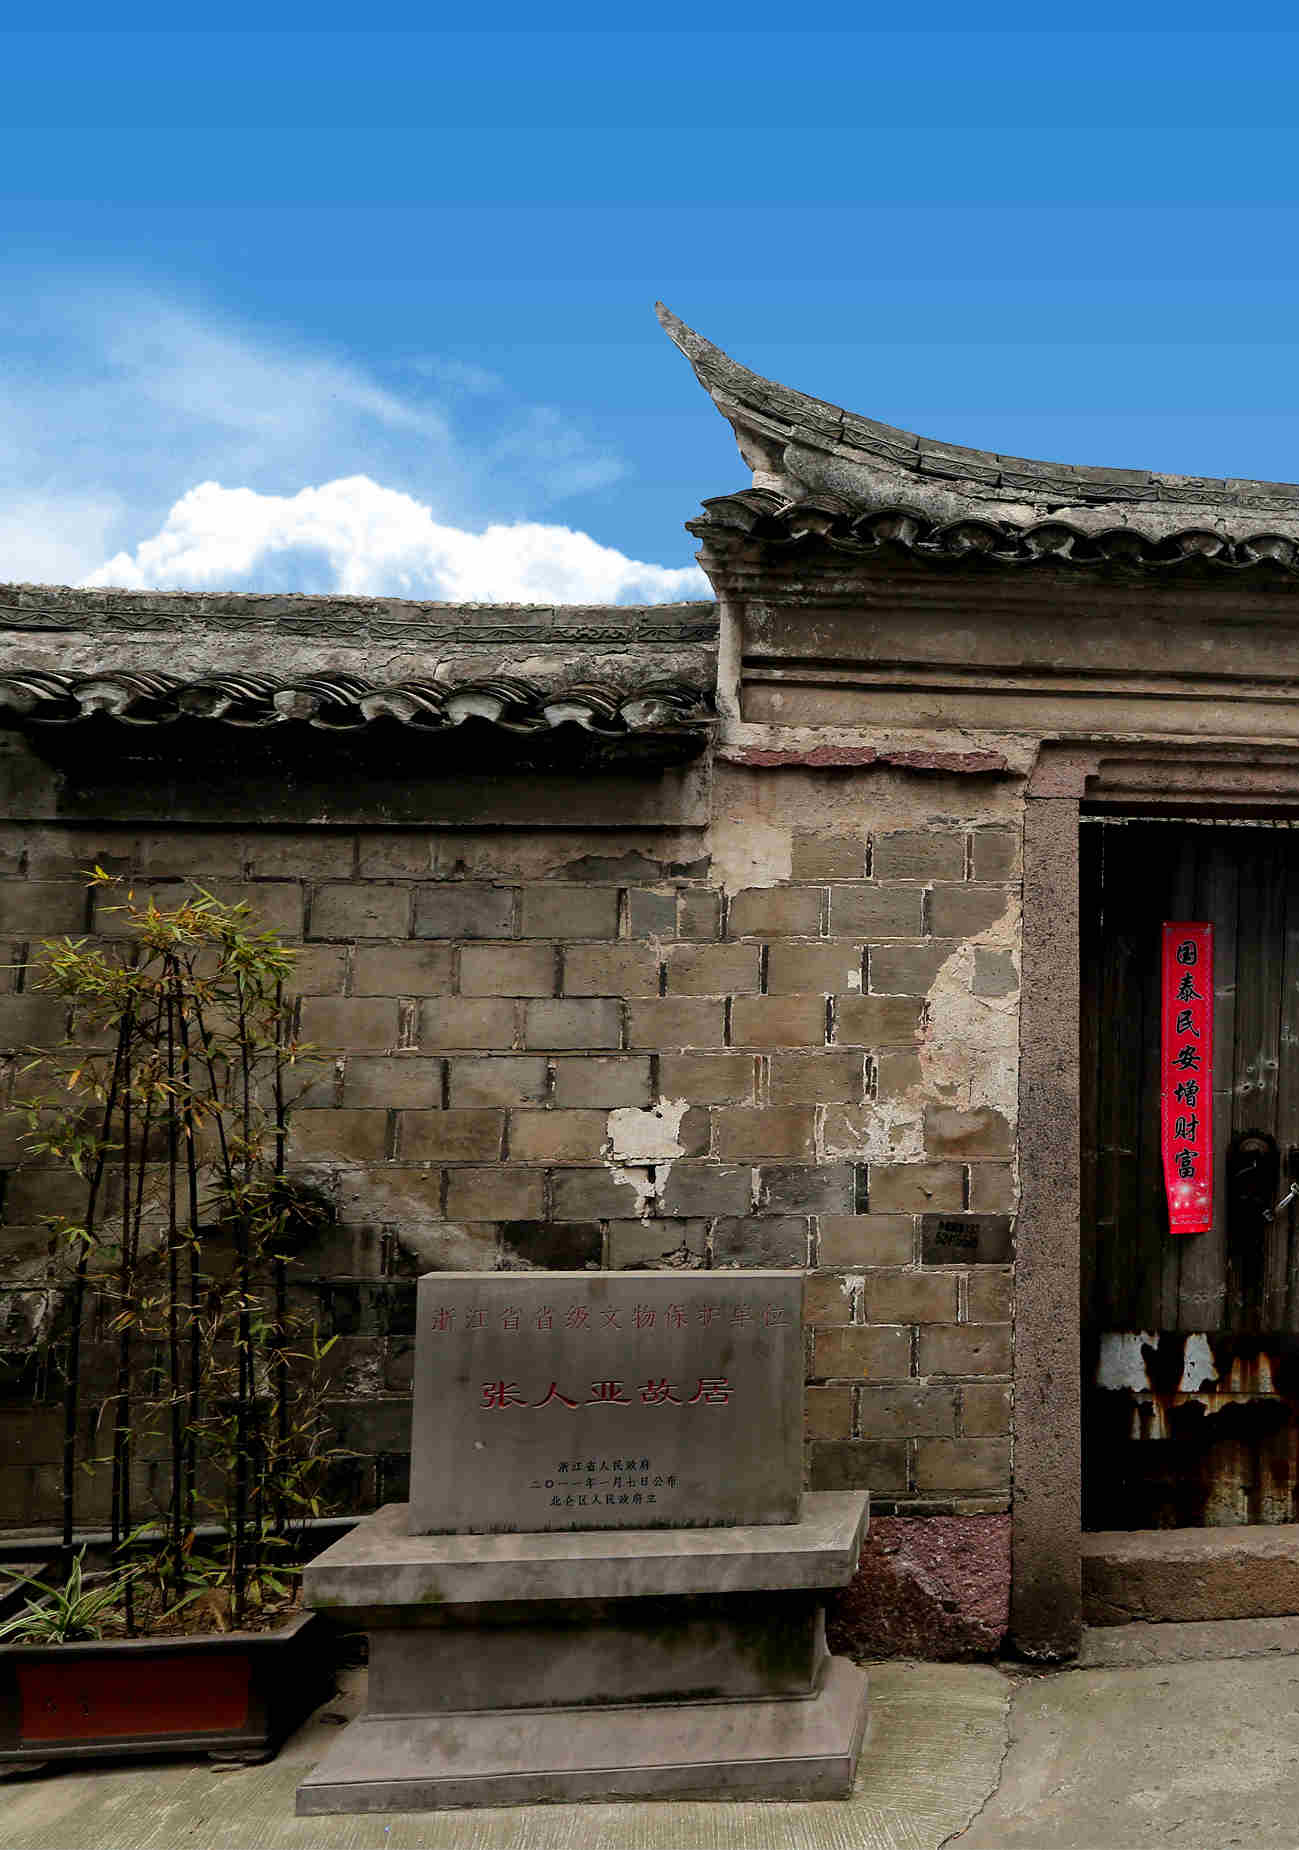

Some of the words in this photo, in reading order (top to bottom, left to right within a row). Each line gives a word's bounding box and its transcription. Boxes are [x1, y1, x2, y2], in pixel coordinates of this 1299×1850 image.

[1171, 940, 1202, 1179] 国泰民安增财富
[431, 1302, 793, 1332] 浙江省省级文物保护单位
[479, 1376, 736, 1409] 张人亚故居
[557, 1458, 650, 1473] 浙江省人民政府
